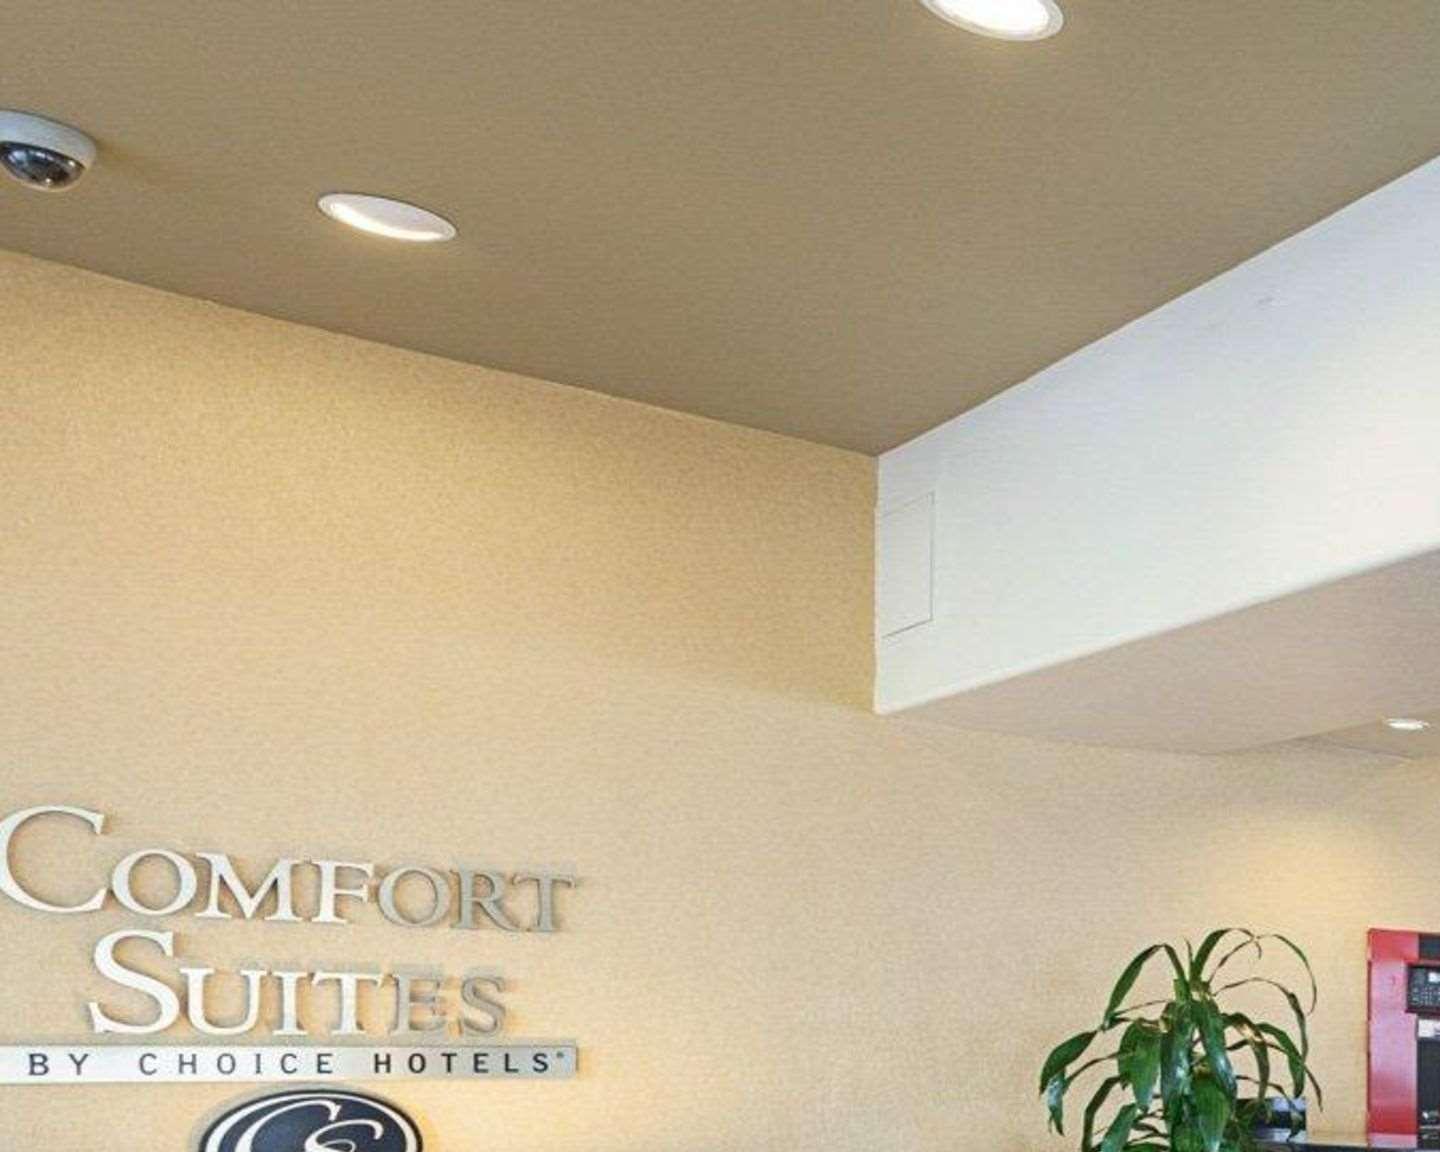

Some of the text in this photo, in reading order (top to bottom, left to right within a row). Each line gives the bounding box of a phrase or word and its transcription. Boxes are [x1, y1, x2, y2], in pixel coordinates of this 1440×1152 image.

[0, 805, 576, 933] COMFORT
[88, 929, 507, 1037] SUITES
[29, 1053, 91, 1076] BY
[138, 1053, 335, 1075] CHOICE
